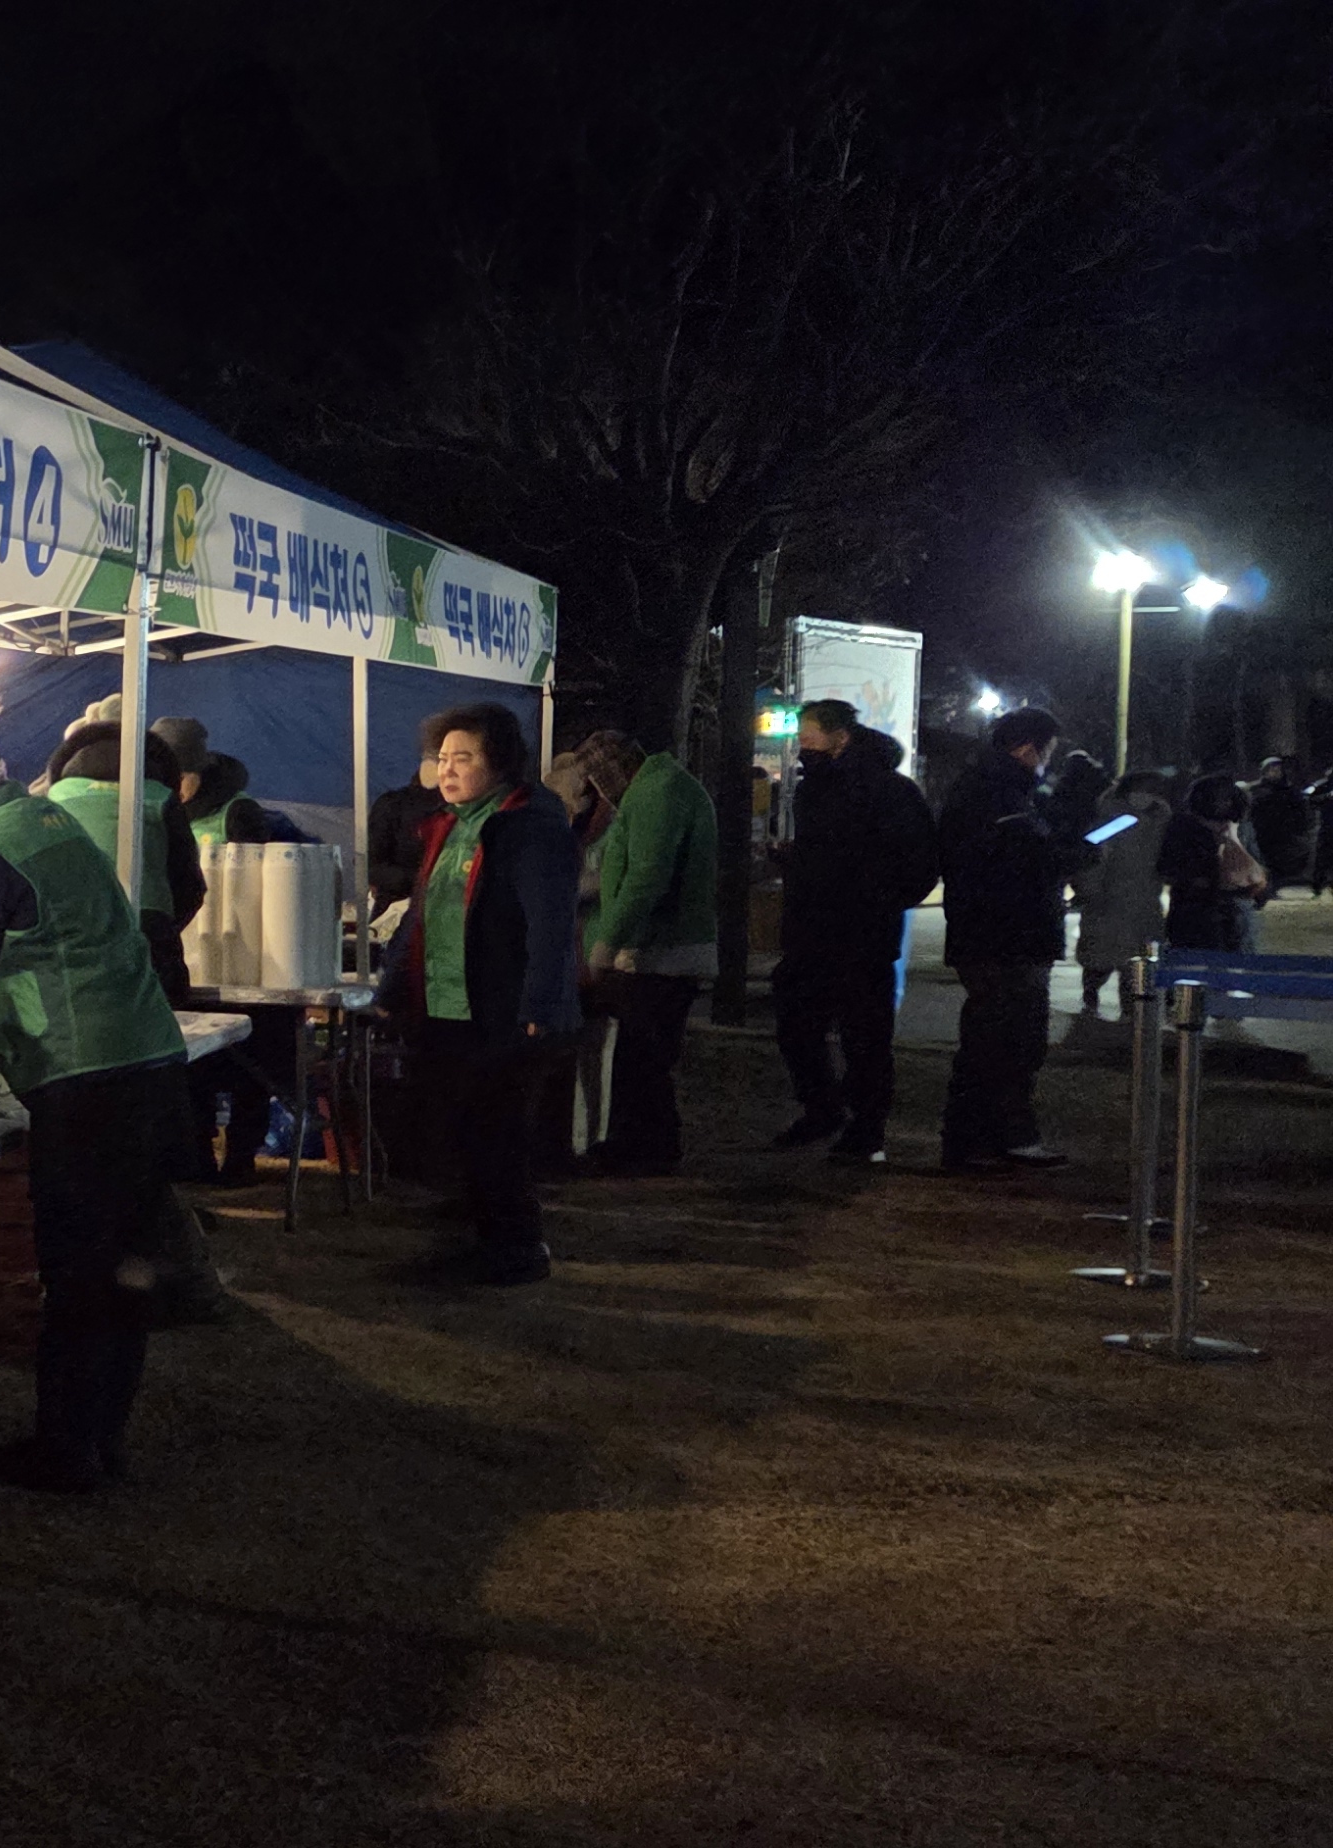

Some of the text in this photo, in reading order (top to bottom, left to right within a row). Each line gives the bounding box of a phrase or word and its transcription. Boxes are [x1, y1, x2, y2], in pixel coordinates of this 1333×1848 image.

[96, 496, 135, 554] SMU
[229, 512, 281, 620] 떡국
[286, 529, 353, 633] 배식처
[443, 581, 475, 658] 떡국
[476, 591, 517, 664] 배식처
